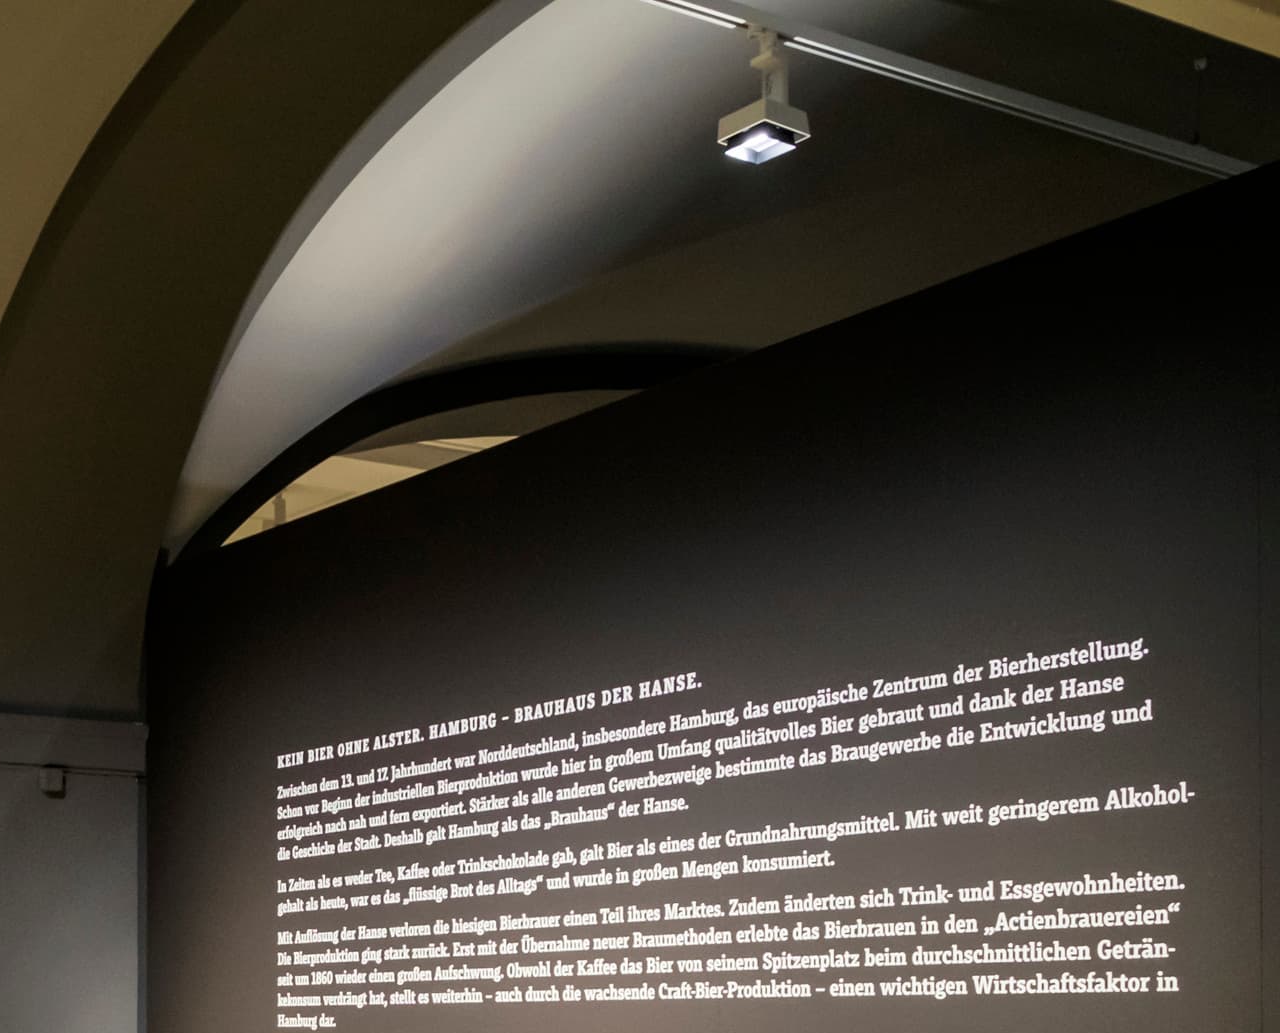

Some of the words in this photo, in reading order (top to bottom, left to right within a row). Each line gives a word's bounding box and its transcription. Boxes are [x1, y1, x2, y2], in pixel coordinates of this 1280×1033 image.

[276, 780, 318, 800] Zwischen
[318, 776, 340, 793] dem
[340, 772, 354, 789] 13.
[356, 768, 375, 786] und
[376, 766, 389, 783] 17.
[390, 756, 452, 784] Jahrhundert
[454, 754, 476, 769] war
[478, 732, 580, 765] Norddeutschland,
[581, 719, 666, 748] insbesondere
[669, 707, 740, 732] Hamburg,
[742, 700, 769, 720] das
[772, 682, 868, 715] europäische
[872, 672, 948, 698] Zentrum
[952, 663, 984, 685] der
[988, 637, 1148, 680] Bierherstellung.
[276, 750, 304, 769] KEIN
[306, 744, 334, 764] BIER
[336, 737, 370, 758] OHNE
[372, 727, 424, 751] ALSTER.
[428, 711, 497, 740] HAMBURG
[514, 691, 596, 724] BRAUHAUS
[600, 684, 633, 707] DER
[638, 671, 702, 700] HANSE.
[276, 820, 324, 841] erfolgreich
[324, 816, 347, 834] nach
[348, 813, 367, 831] nah
[368, 809, 388, 828] und
[388, 808, 410, 825] fern
[411, 800, 467, 824] exportiert.
[468, 793, 510, 814] Stärker
[511, 789, 529, 808] als
[530, 786, 554, 805] alle
[555, 781, 606, 801] anderen
[608, 764, 712, 794] Gewerbezweige
[714, 753, 795, 779] bestimmte
[798, 747, 826, 768] das
[830, 730, 942, 764] Braugewerbe
[946, 725, 974, 747] die
[979, 709, 1106, 743] Entwicklung
[1110, 698, 1153, 725] und
[276, 951, 292, 966] Die
[292, 947, 360, 968] Bierproduktion
[360, 946, 382, 965] ging
[383, 943, 410, 961] stark
[410, 941, 450, 960] zurück.
[452, 941, 476, 957] Erst
[476, 938, 498, 956] mit
[498, 937, 519, 955] der
[520, 933, 590, 954] Übernahme
[592, 935, 630, 951] neuer
[632, 926, 732, 949] Braumethoden
[735, 922, 788, 944] erlebte
[792, 921, 820, 941] das
[823, 917, 916, 939] Bierbrauen
[920, 914, 940, 935] in
[944, 913, 978, 934] den
[983, 901, 1180, 936] „Actienbrauereien“
